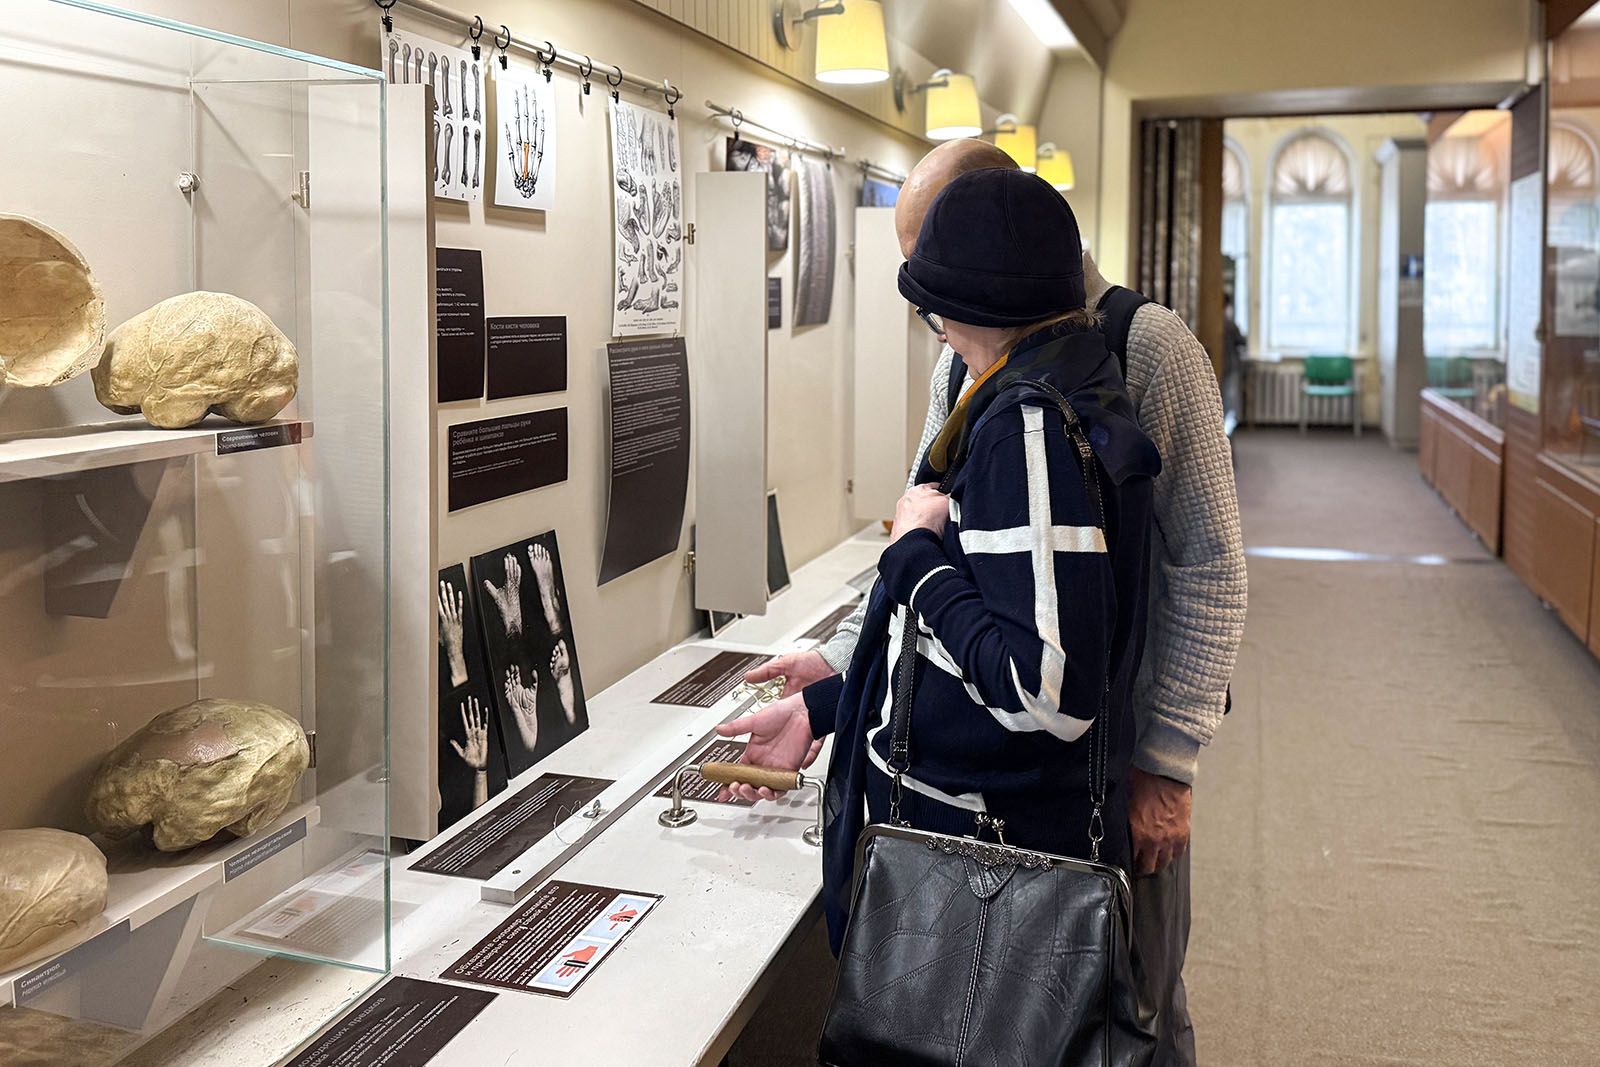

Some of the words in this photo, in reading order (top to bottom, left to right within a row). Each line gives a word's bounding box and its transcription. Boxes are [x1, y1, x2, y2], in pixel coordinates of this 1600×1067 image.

[454, 941, 494, 974] Обхватите
[493, 916, 525, 942] силомер,
[472, 940, 508, 971] проверьте
[523, 908, 543, 926] своей
[540, 896, 558, 909] руки
[21, 963, 61, 988] Синантроп
[348, 997, 386, 1027] предков
